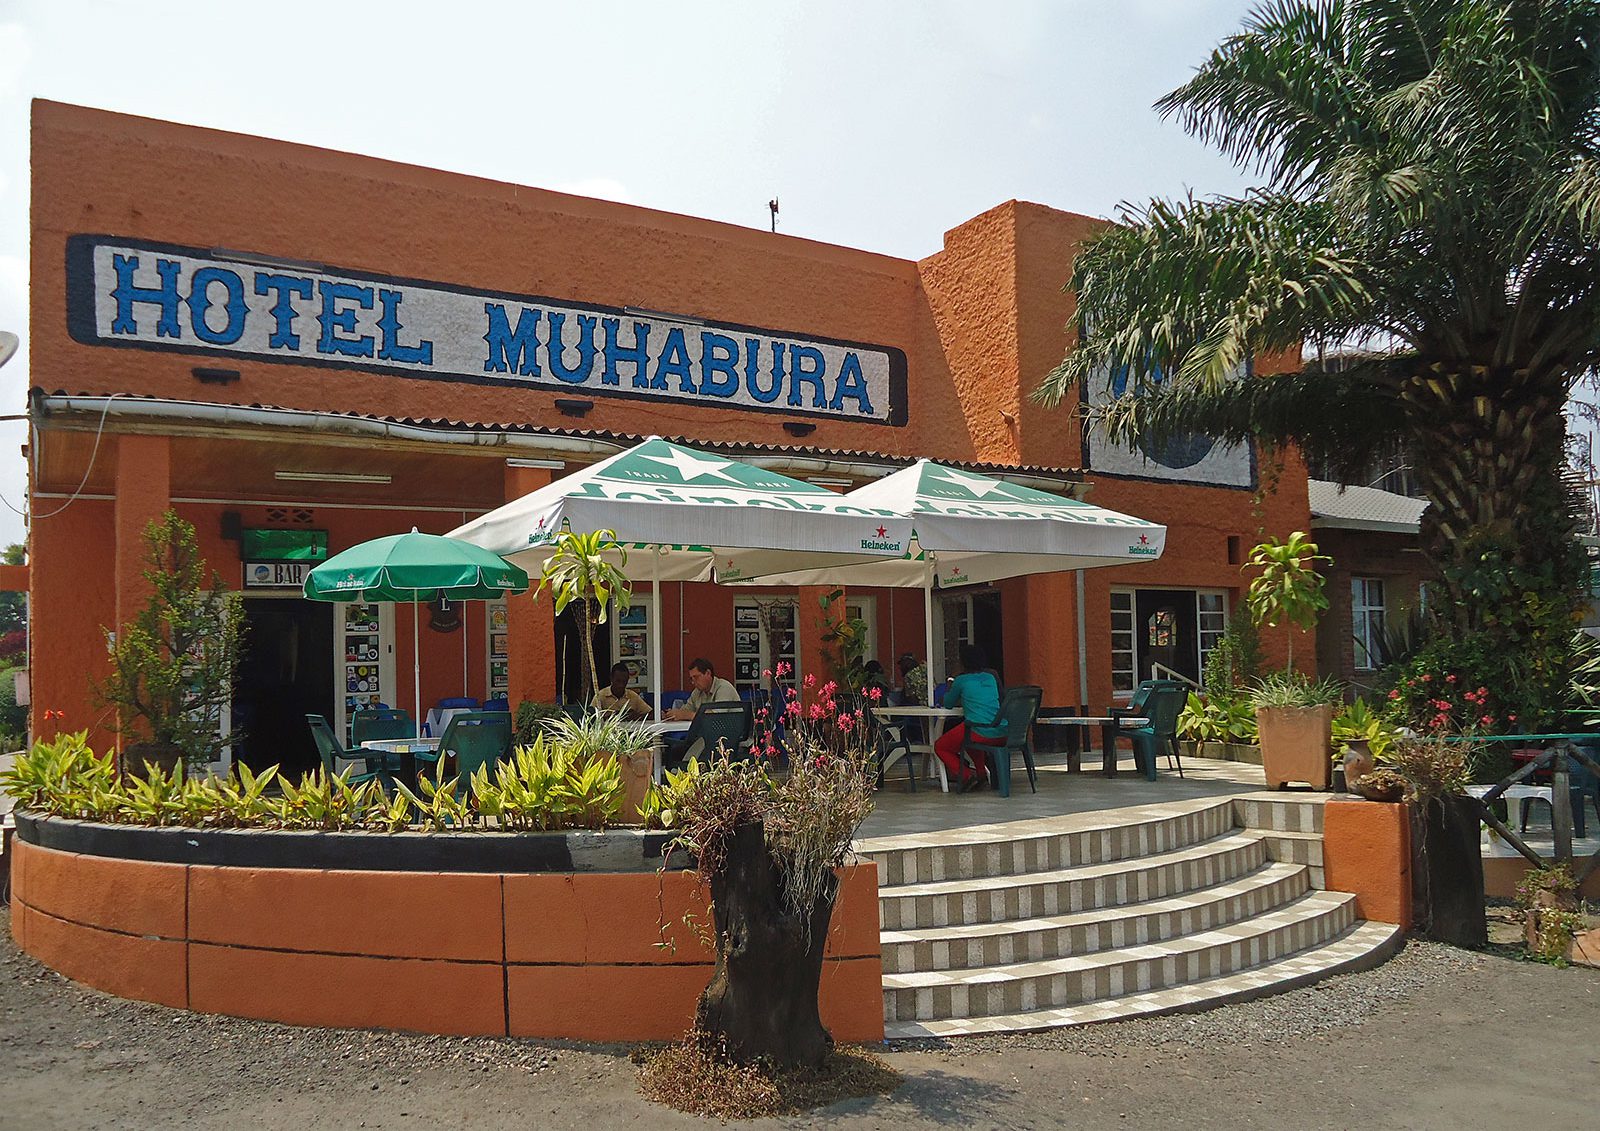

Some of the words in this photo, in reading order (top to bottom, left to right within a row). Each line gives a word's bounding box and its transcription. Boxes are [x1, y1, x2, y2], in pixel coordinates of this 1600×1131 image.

[110, 253, 434, 366] HOTEL
[483, 302, 874, 415] MUHABURA
[624, 470, 669, 480] TRADE
[860, 539, 900, 551] Heineken
[274, 564, 303, 584] BAR
